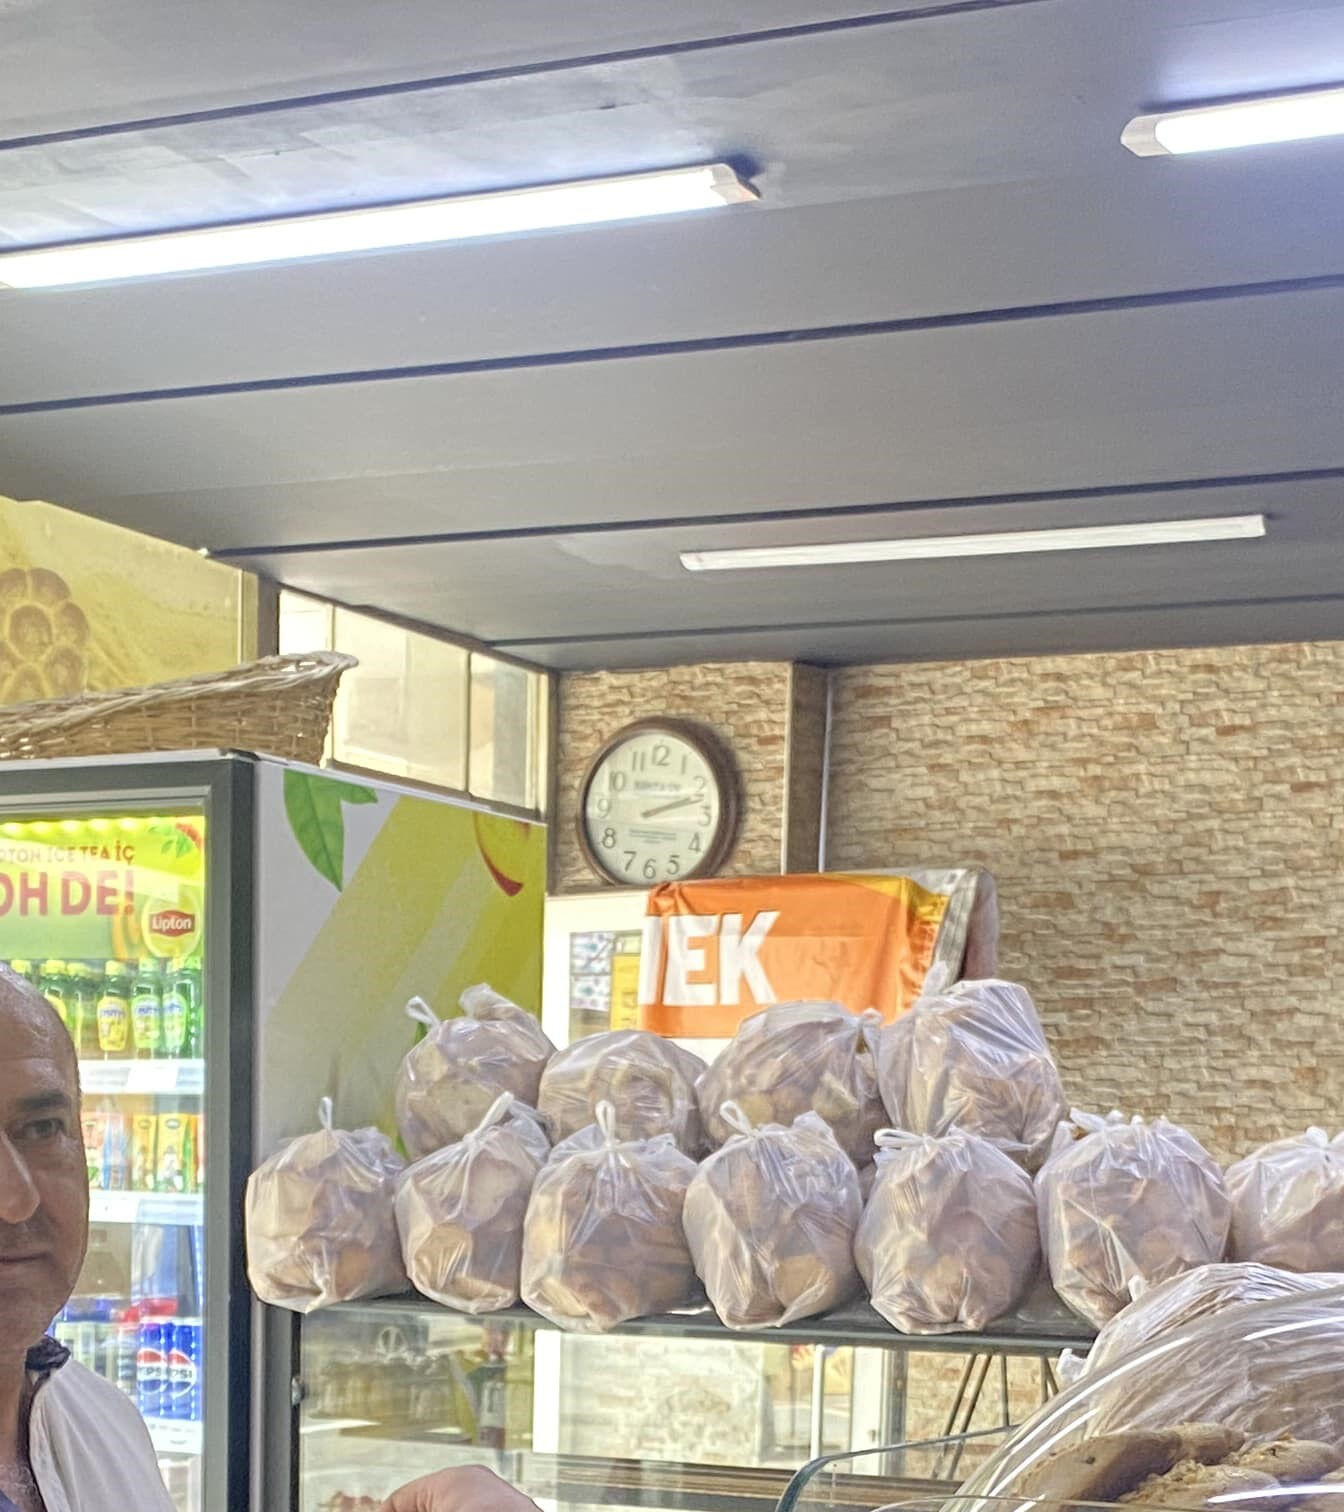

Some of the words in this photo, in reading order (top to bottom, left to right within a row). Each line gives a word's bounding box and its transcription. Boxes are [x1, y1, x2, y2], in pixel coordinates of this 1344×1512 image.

[632, 752, 646, 771] 11
[652, 745, 670, 766] 12
[681, 755, 687, 775] 1
[609, 771, 626, 792] 10
[693, 775, 706, 797] 2
[597, 799, 611, 819] 9
[602, 828, 616, 849] 8
[688, 832, 701, 852] 4
[47, 848, 76, 864] ICE
[79, 846, 110, 861] TEA
[115, 840, 135, 866] İÇ
[624, 851, 637, 872] 7
[643, 858, 656, 879] 6
[667, 854, 680, 875] 5
[61, 869, 135, 916] DE!
[151, 914, 192, 932] Lipton
